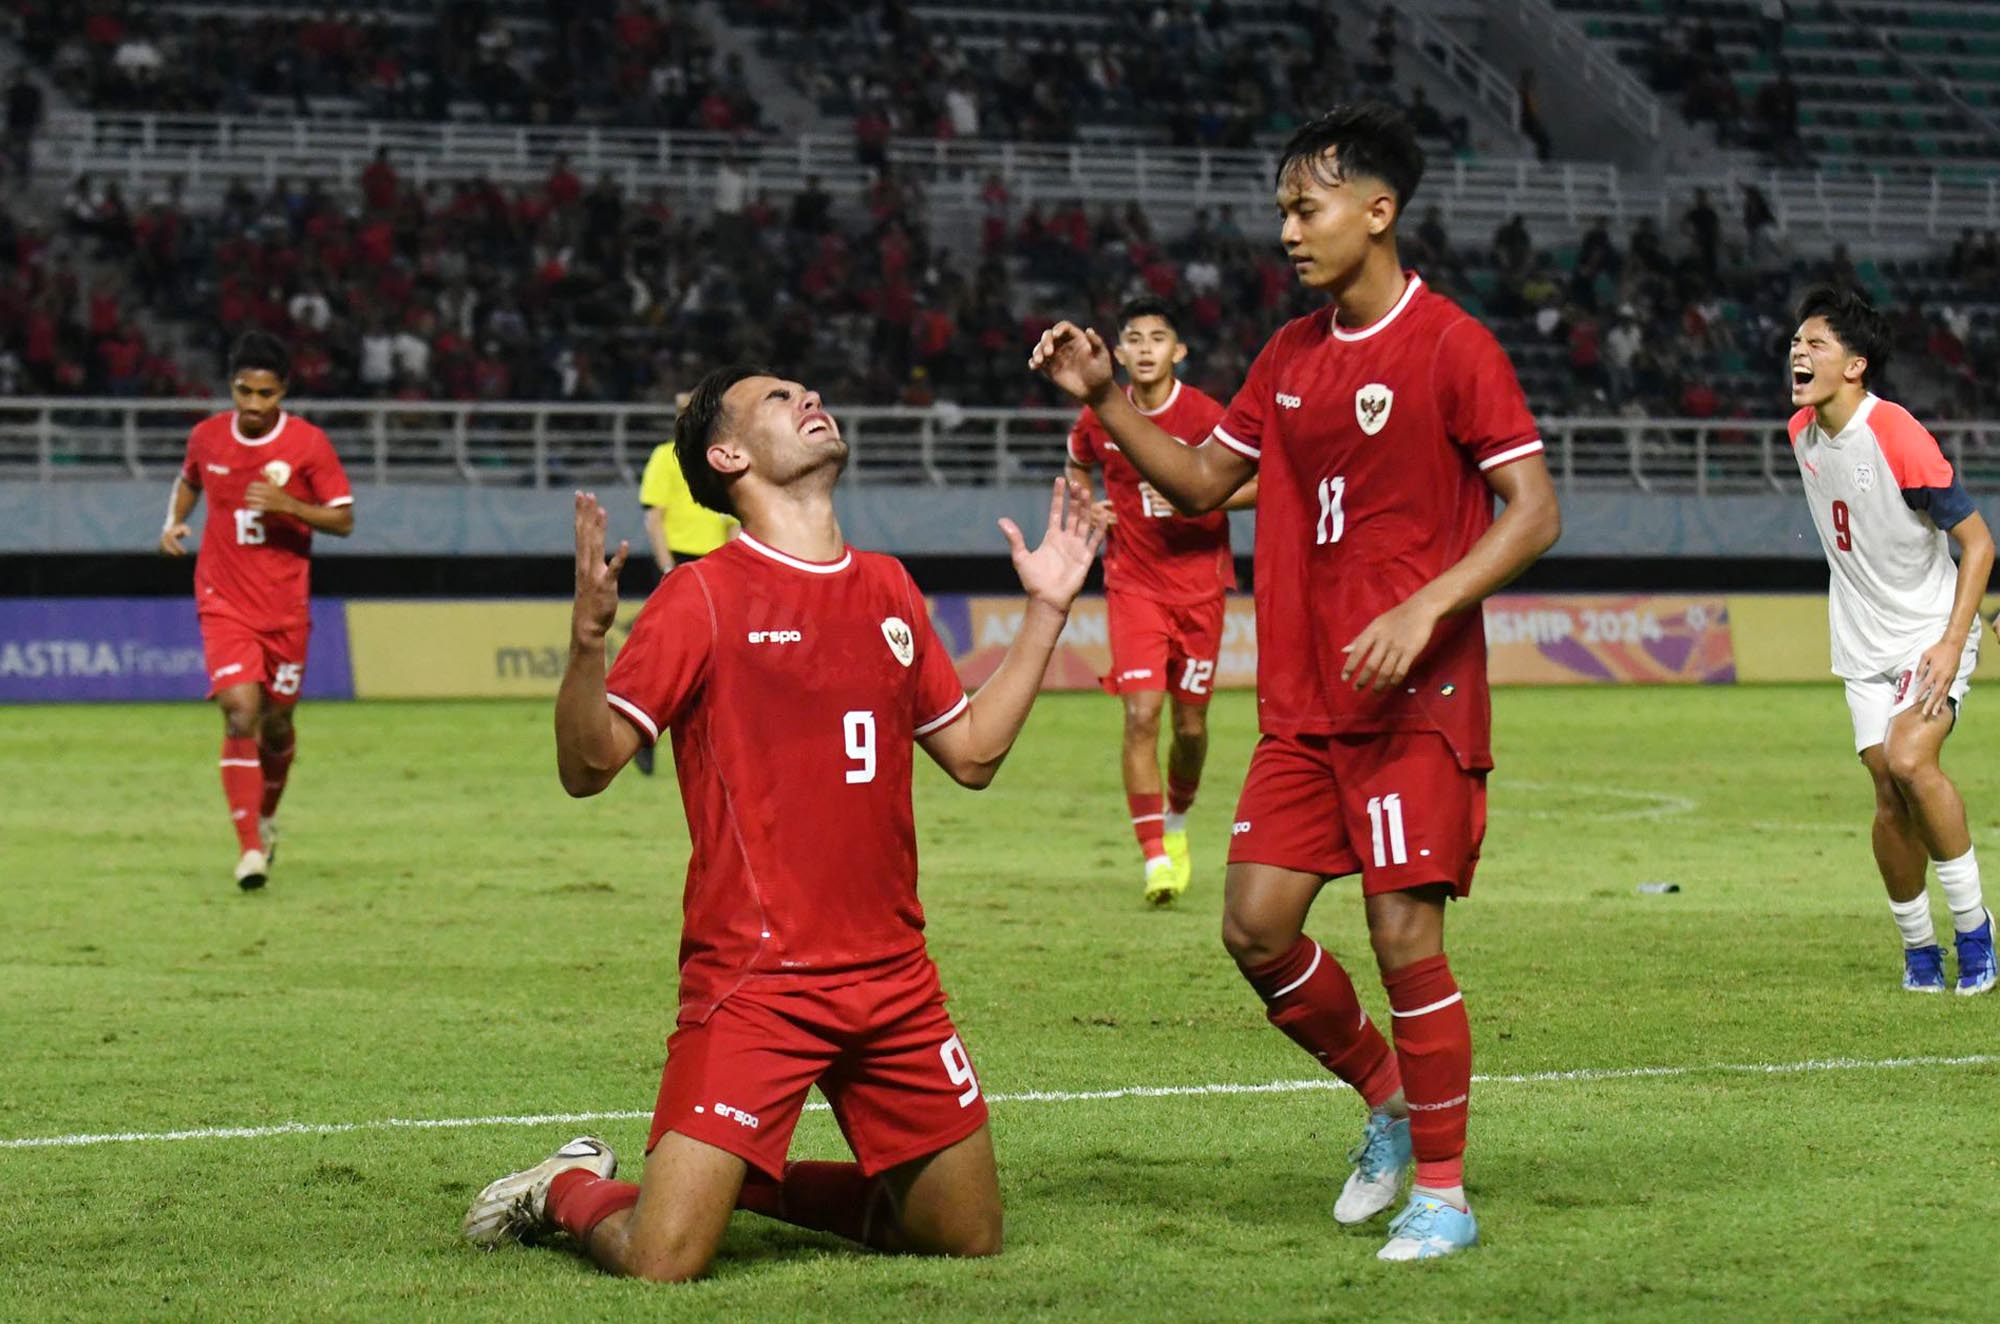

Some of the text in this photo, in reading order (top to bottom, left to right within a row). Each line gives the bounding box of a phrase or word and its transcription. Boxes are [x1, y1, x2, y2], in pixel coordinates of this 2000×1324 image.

[234, 509, 266, 546] 15
[1317, 476, 1346, 546] 11
[1832, 500, 1852, 552] 9
[749, 631, 802, 645] erspo
[1579, 608, 1662, 644] 2024
[1, 640, 120, 678] ASTRA
[1180, 658, 1213, 695] 12
[273, 662, 302, 696] 15
[843, 711, 877, 785] 9
[1367, 793, 1408, 868] 11
[939, 1033, 979, 1109] 9
[714, 1102, 759, 1129] erspo
